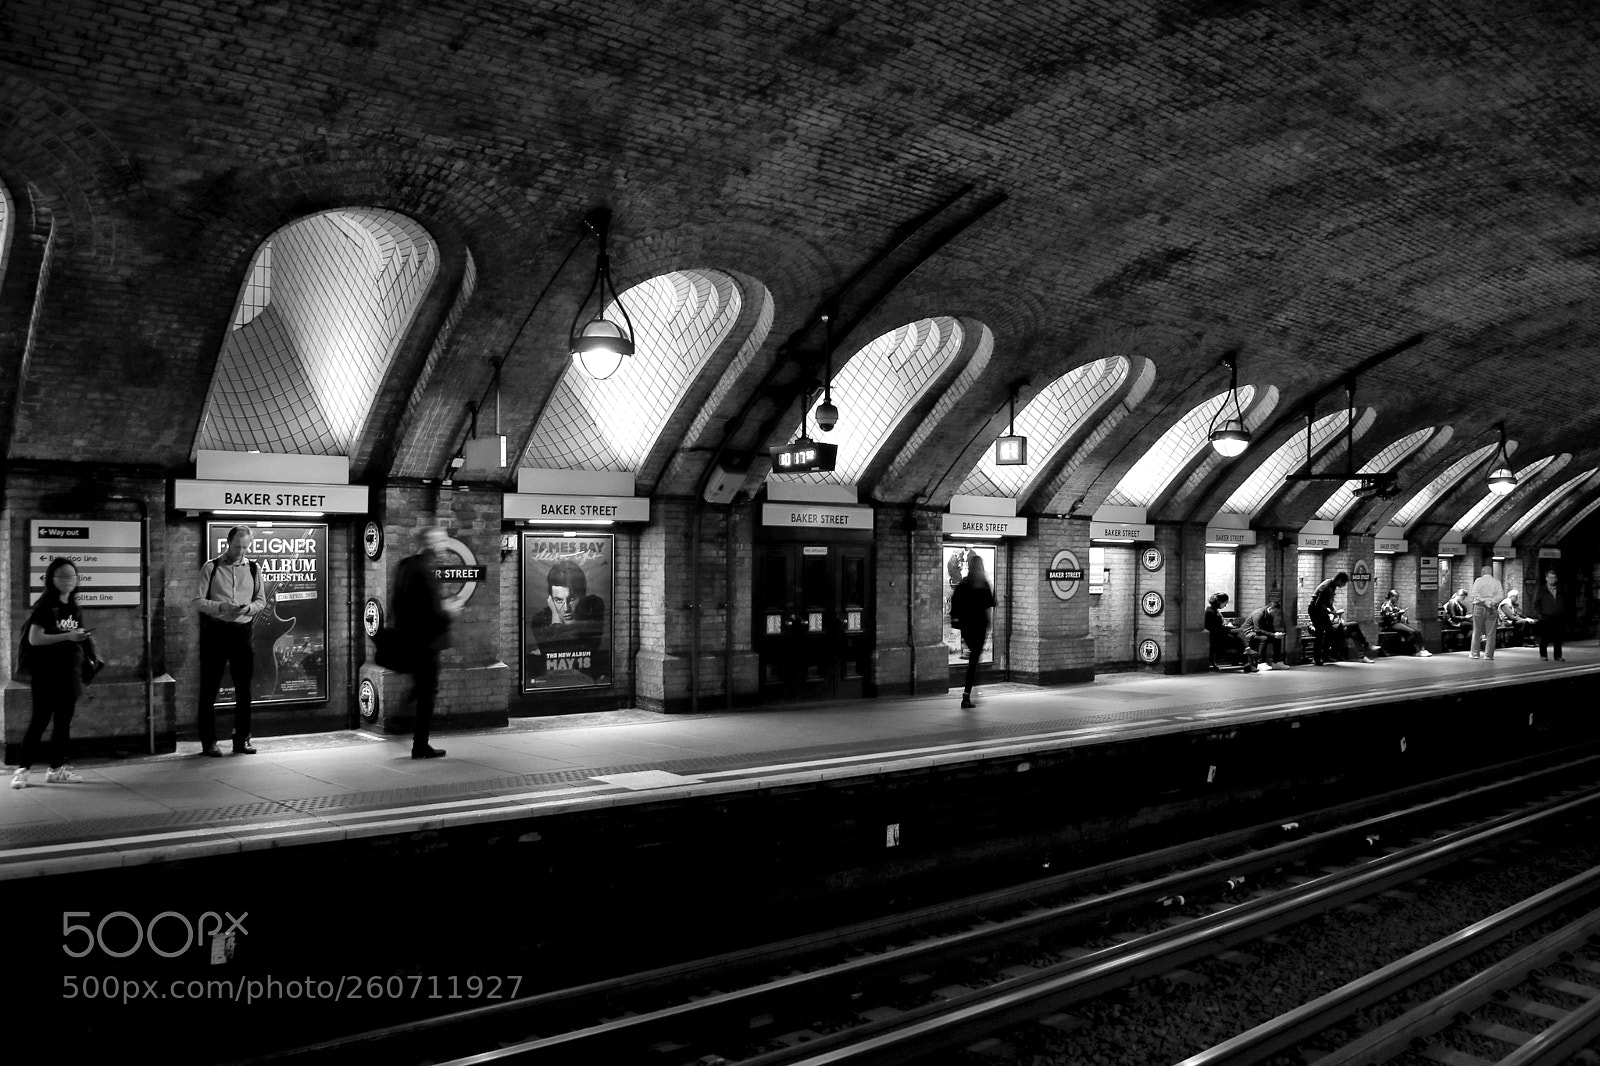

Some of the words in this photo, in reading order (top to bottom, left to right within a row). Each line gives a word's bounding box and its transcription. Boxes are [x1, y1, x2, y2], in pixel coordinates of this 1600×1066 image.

[225, 492, 271, 506] BAKER
[276, 493, 326, 507] STREET
[541, 504, 576, 516] BAKER
[580, 505, 618, 517] STREET
[791, 513, 818, 524] BAKER
[820, 514, 849, 525] STREET
[962, 522, 984, 532] BAKER
[985, 523, 1008, 532] STREET
[48, 528, 65, 537] Way
[1104, 529, 1121, 537] BAKER
[1122, 529, 1140, 538] STREET
[1215, 534, 1229, 542] BAKER
[1229, 534, 1245, 542] STREET
[532, 541, 577, 553] JAMES
[579, 541, 605, 553] BAY
[262, 558, 317, 572] ALBUM
[262, 573, 317, 582] RCHESTRAL
[444, 569, 479, 579] STREET
[1049, 571, 1064, 579] BAKER
[1065, 571, 1082, 579] STREET
[546, 658, 575, 671] MAY
[577, 656, 591, 669] 18
